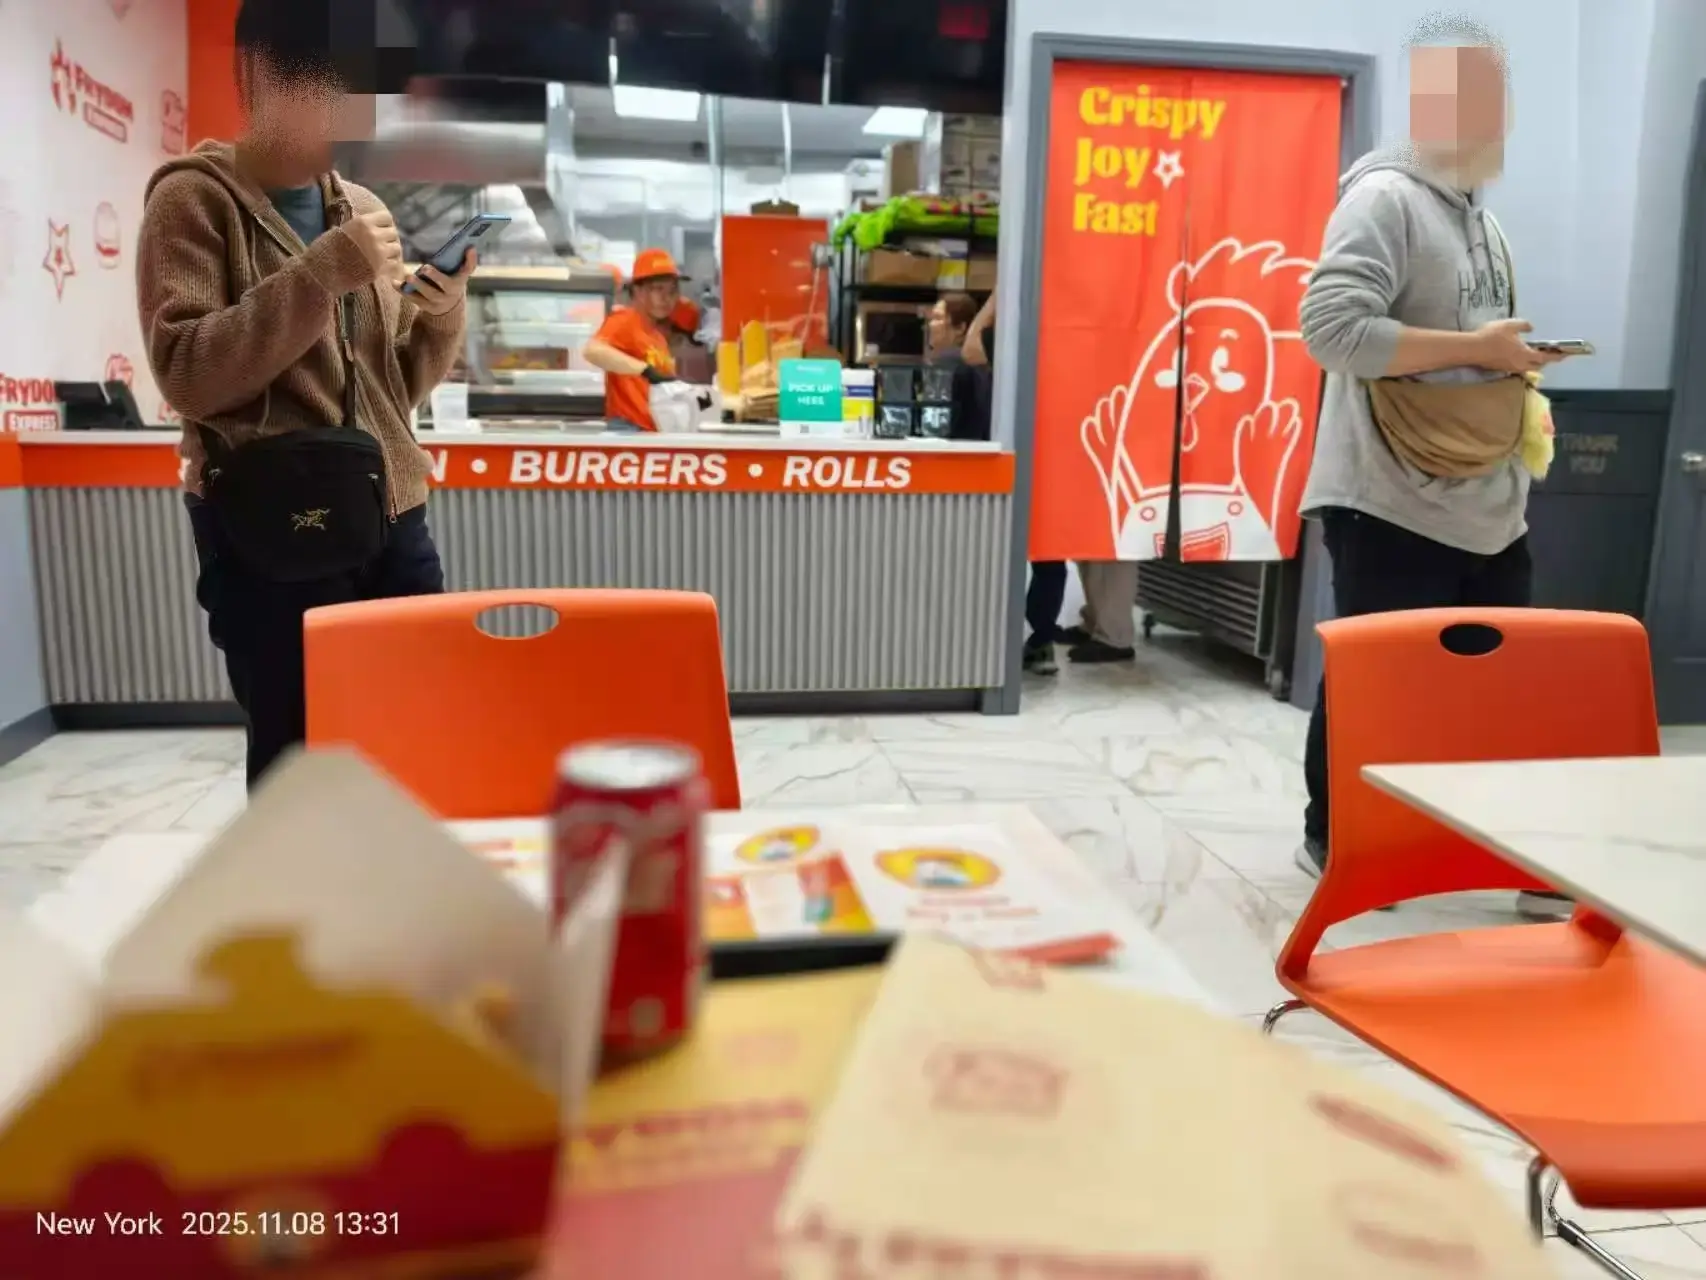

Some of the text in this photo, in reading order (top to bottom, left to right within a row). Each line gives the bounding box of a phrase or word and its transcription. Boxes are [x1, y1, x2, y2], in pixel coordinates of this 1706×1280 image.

[1079, 84, 1227, 140] Crispy
[1073, 137, 1151, 188] Joy
[1073, 192, 1159, 237] Fast
[817, 383, 834, 394] UP
[510, 451, 727, 487] BURGERS
[782, 456, 912, 488] ROLLS
